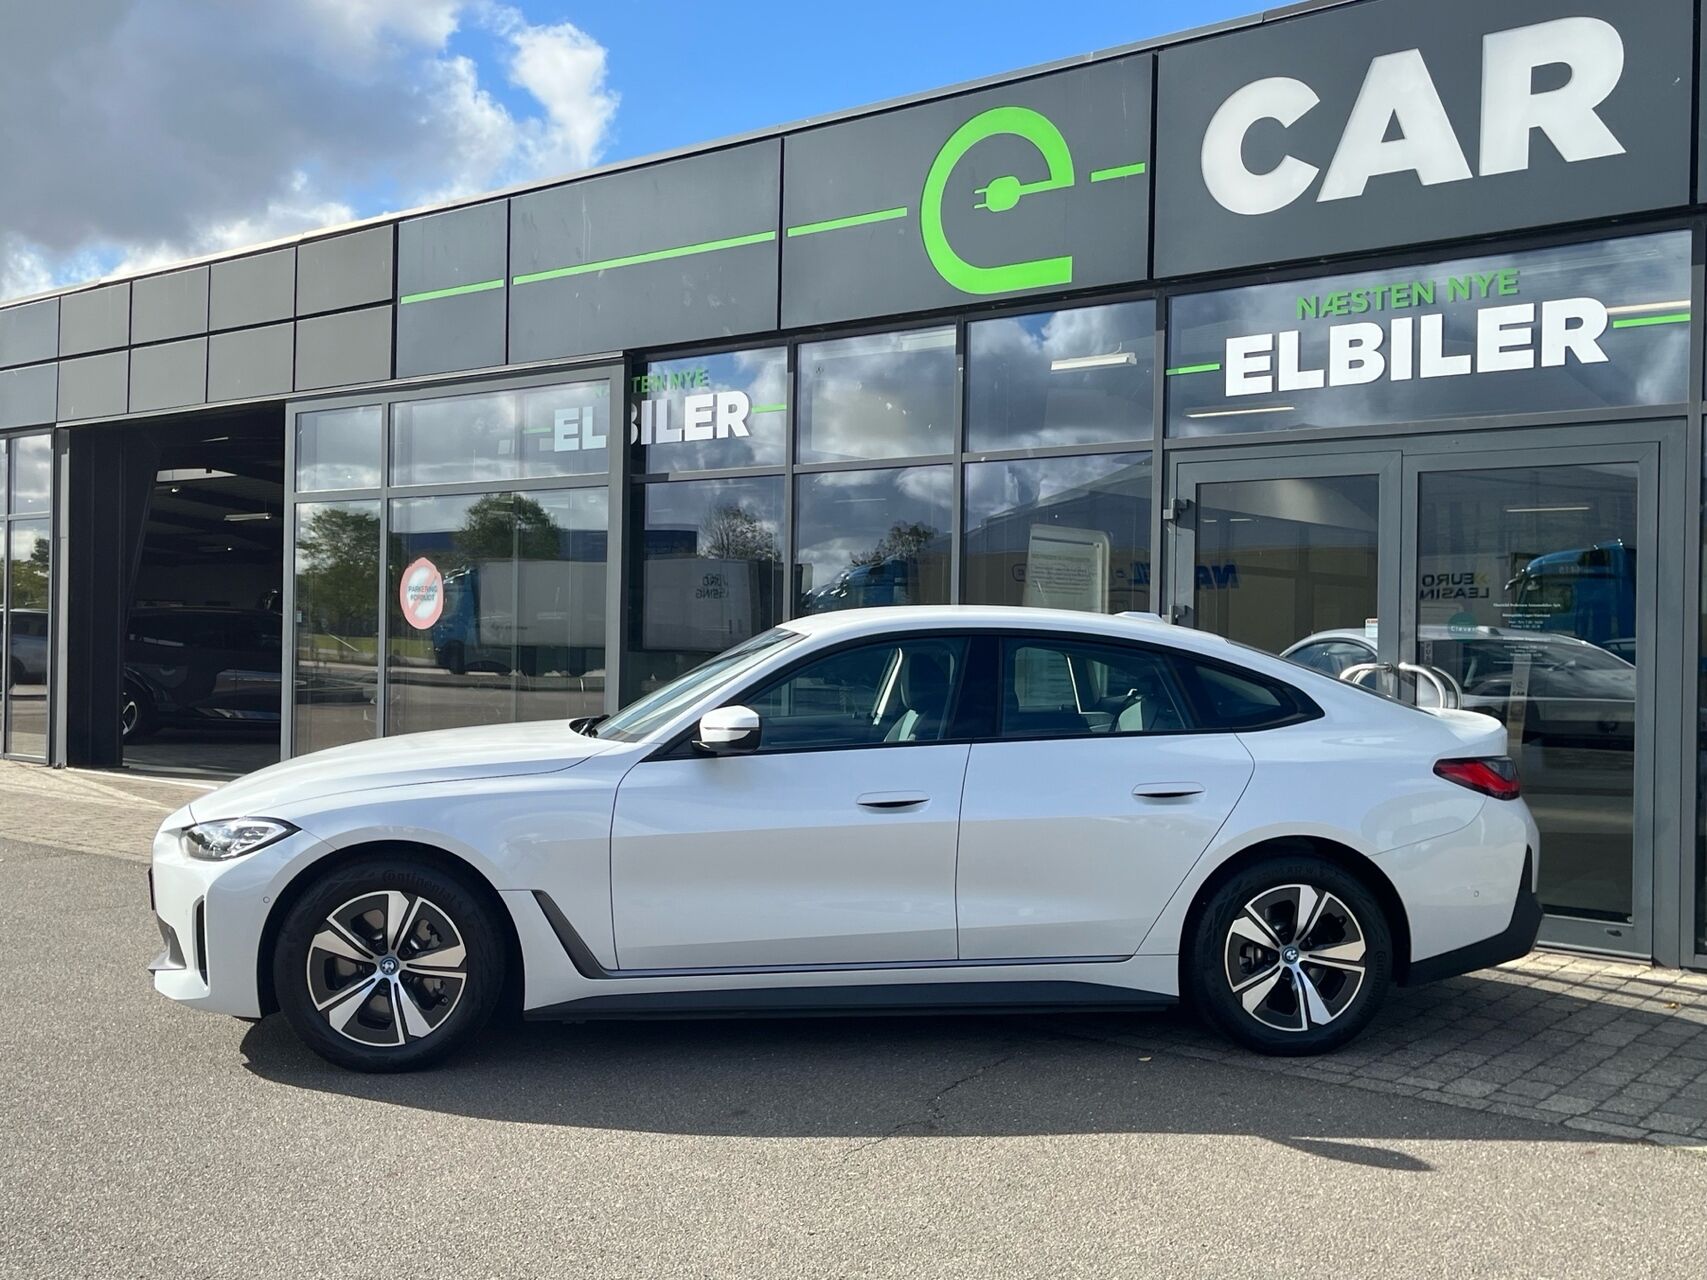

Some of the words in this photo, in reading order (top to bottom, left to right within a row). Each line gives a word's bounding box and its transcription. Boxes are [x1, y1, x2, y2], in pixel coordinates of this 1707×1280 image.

[1201, 16, 1626, 215] CAR
[1296, 279, 1437, 320] NÆSTEN
[1448, 267, 1520, 301] NYE
[671, 367, 709, 390] NYE
[1225, 297, 1609, 397] ELBILER
